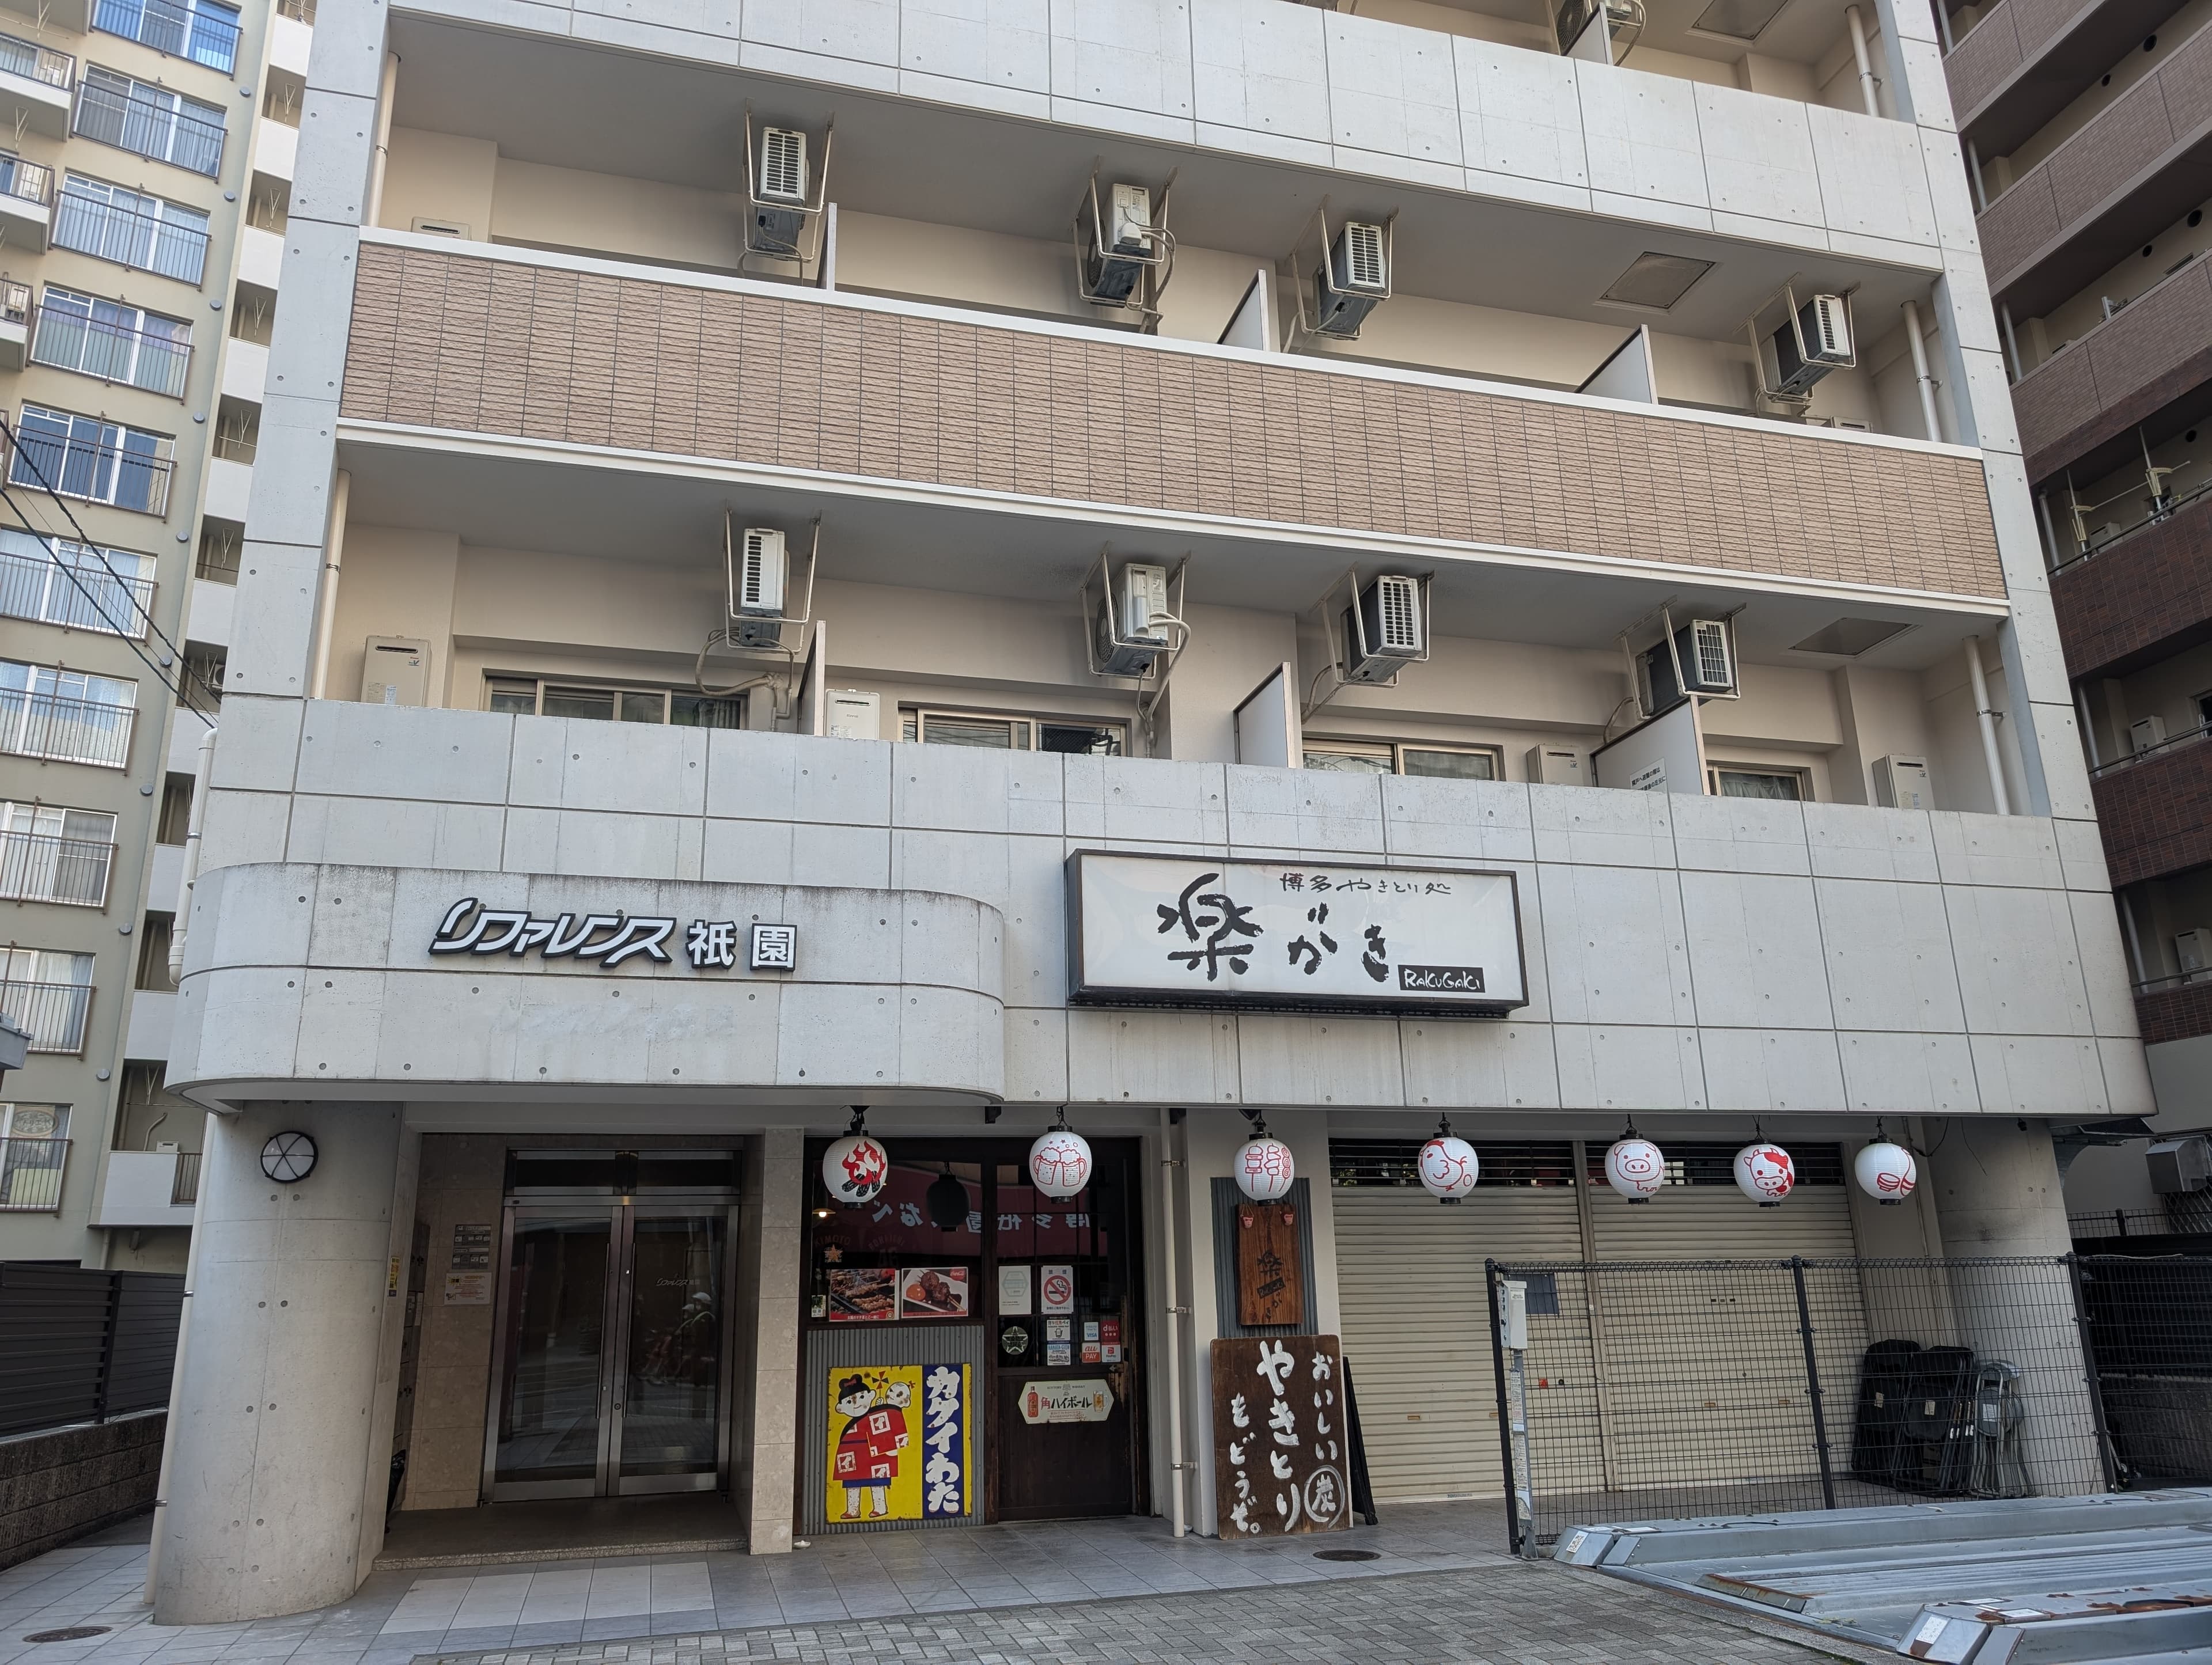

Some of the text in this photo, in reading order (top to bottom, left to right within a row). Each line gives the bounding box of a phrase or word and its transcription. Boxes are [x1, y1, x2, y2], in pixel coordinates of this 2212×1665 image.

[1156, 872, 1390, 982] 楽がき
[1279, 872, 1452, 894] 博多やきとり処
[925, 1366, 961, 1514] カクイわた
[1040, 1395, 1093, 1410] 角ハイボール
[1256, 1340, 1301, 1532] やきとり
